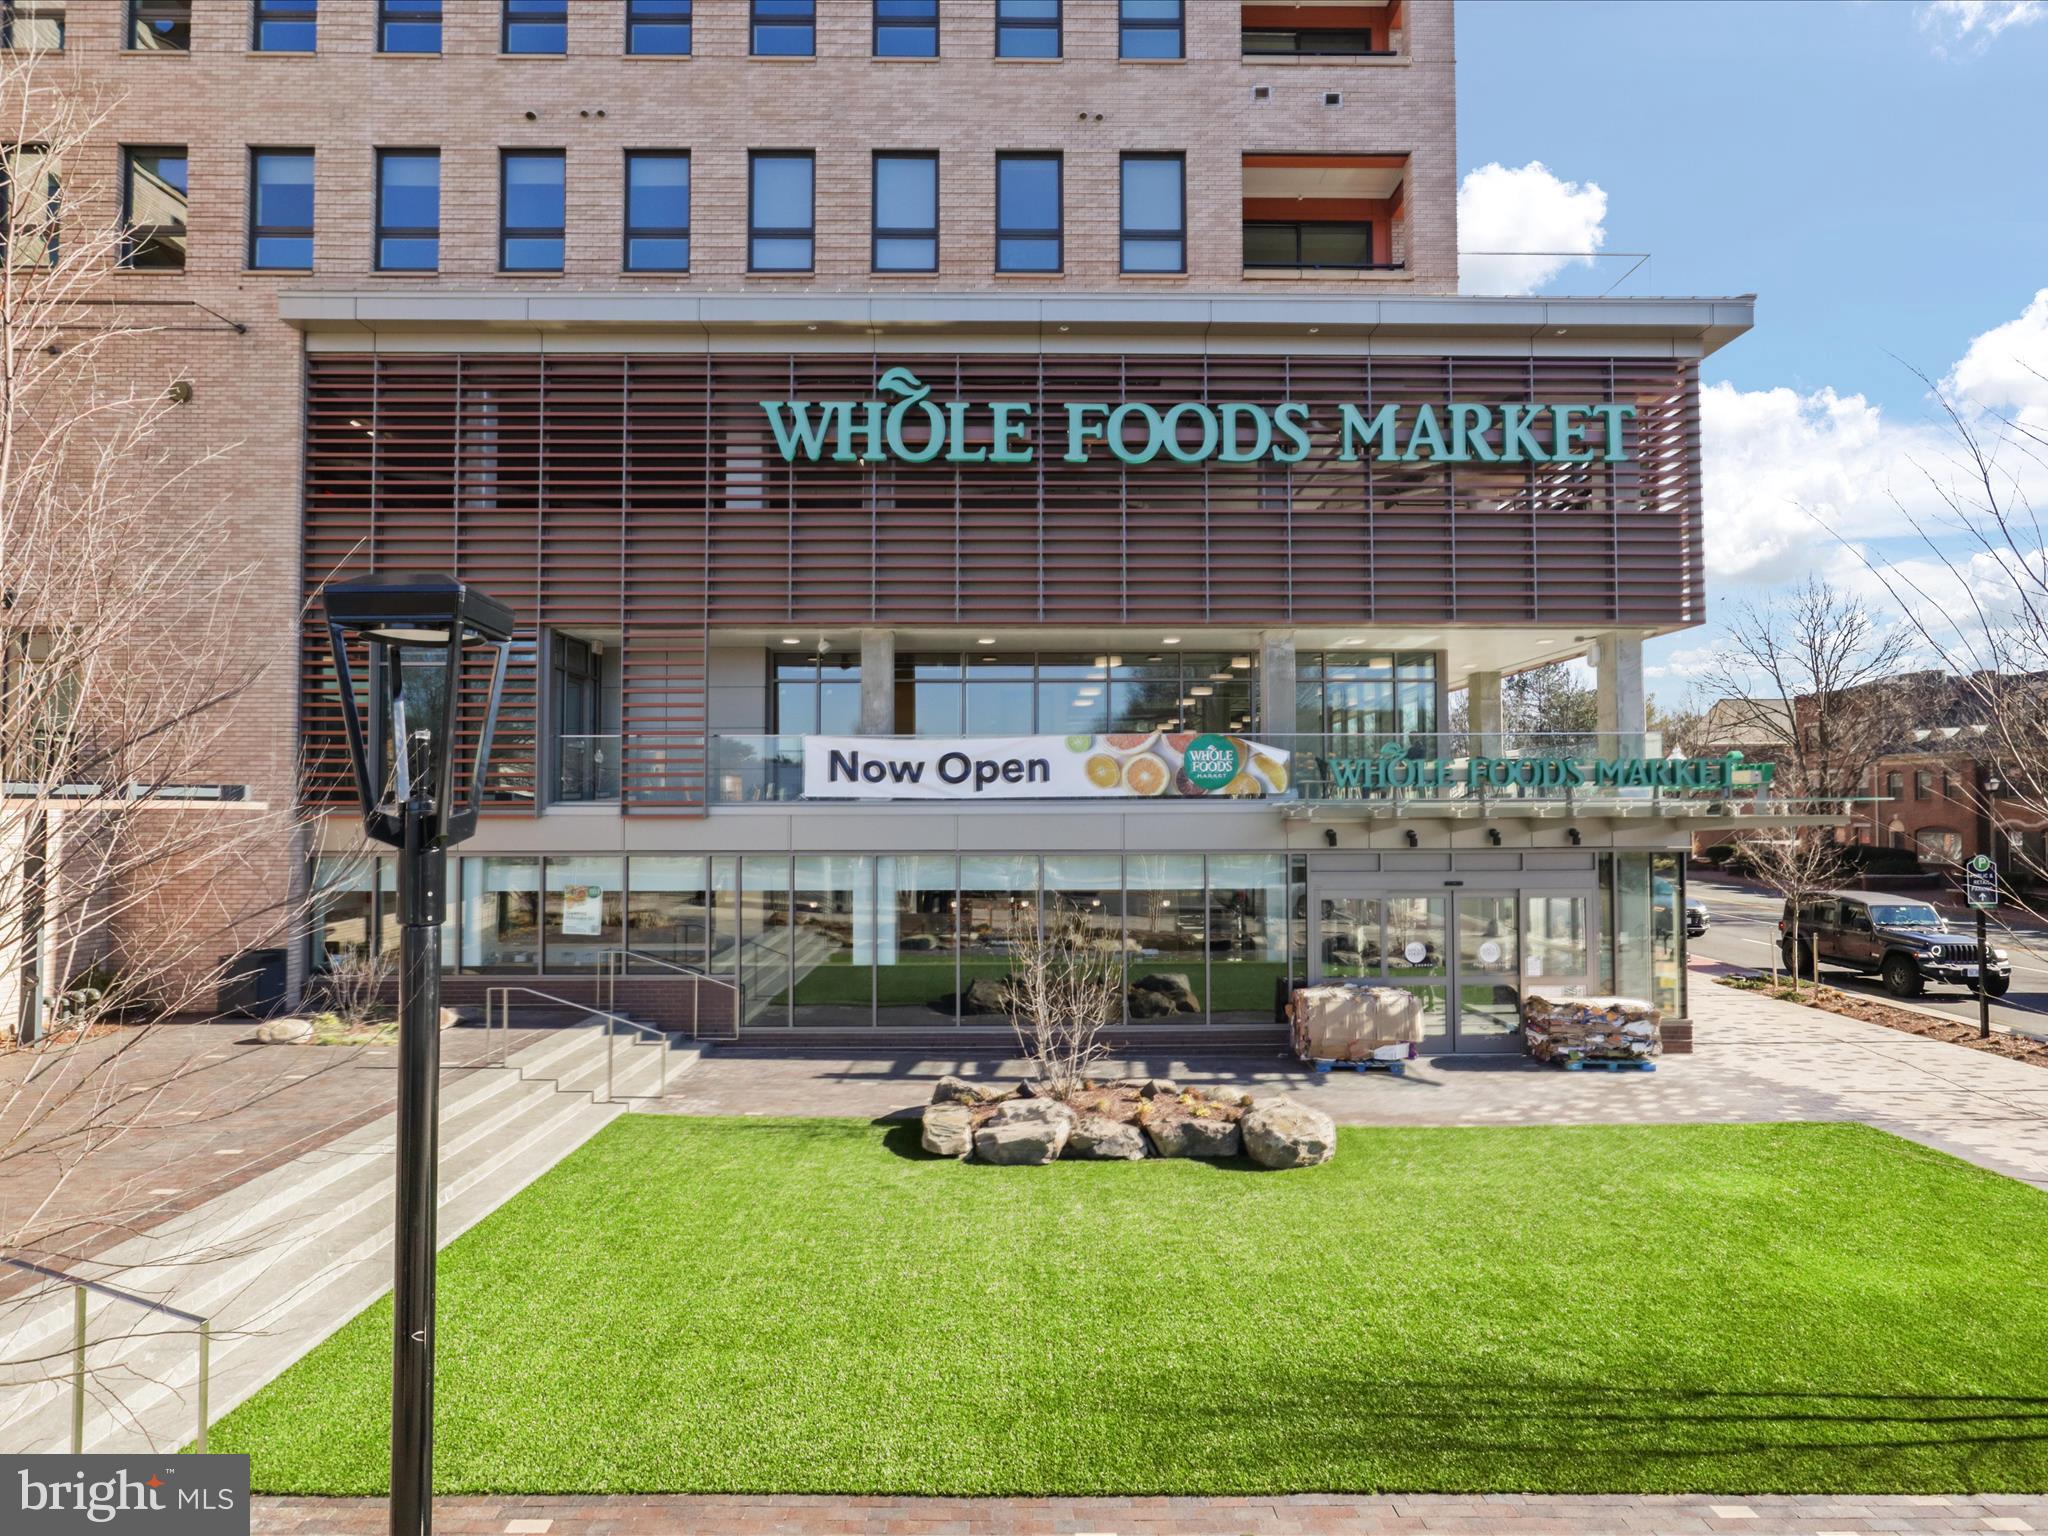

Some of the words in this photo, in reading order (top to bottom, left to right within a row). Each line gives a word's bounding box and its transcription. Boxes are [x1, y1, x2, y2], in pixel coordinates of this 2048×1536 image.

[760, 399, 1034, 465] WHOLE
[1063, 401, 1312, 465] FOODS
[1337, 402, 1638, 463] MARKET
[1189, 749, 1234, 761] WHOLE
[827, 750, 924, 784] Now
[936, 751, 1051, 792] Open
[1191, 761, 1233, 772] FOODS
[1328, 757, 1456, 788] WHOLE
[1467, 756, 1584, 788] FOODS
[1594, 757, 1735, 787] MARKET
[1978, 857, 1986, 869] P
